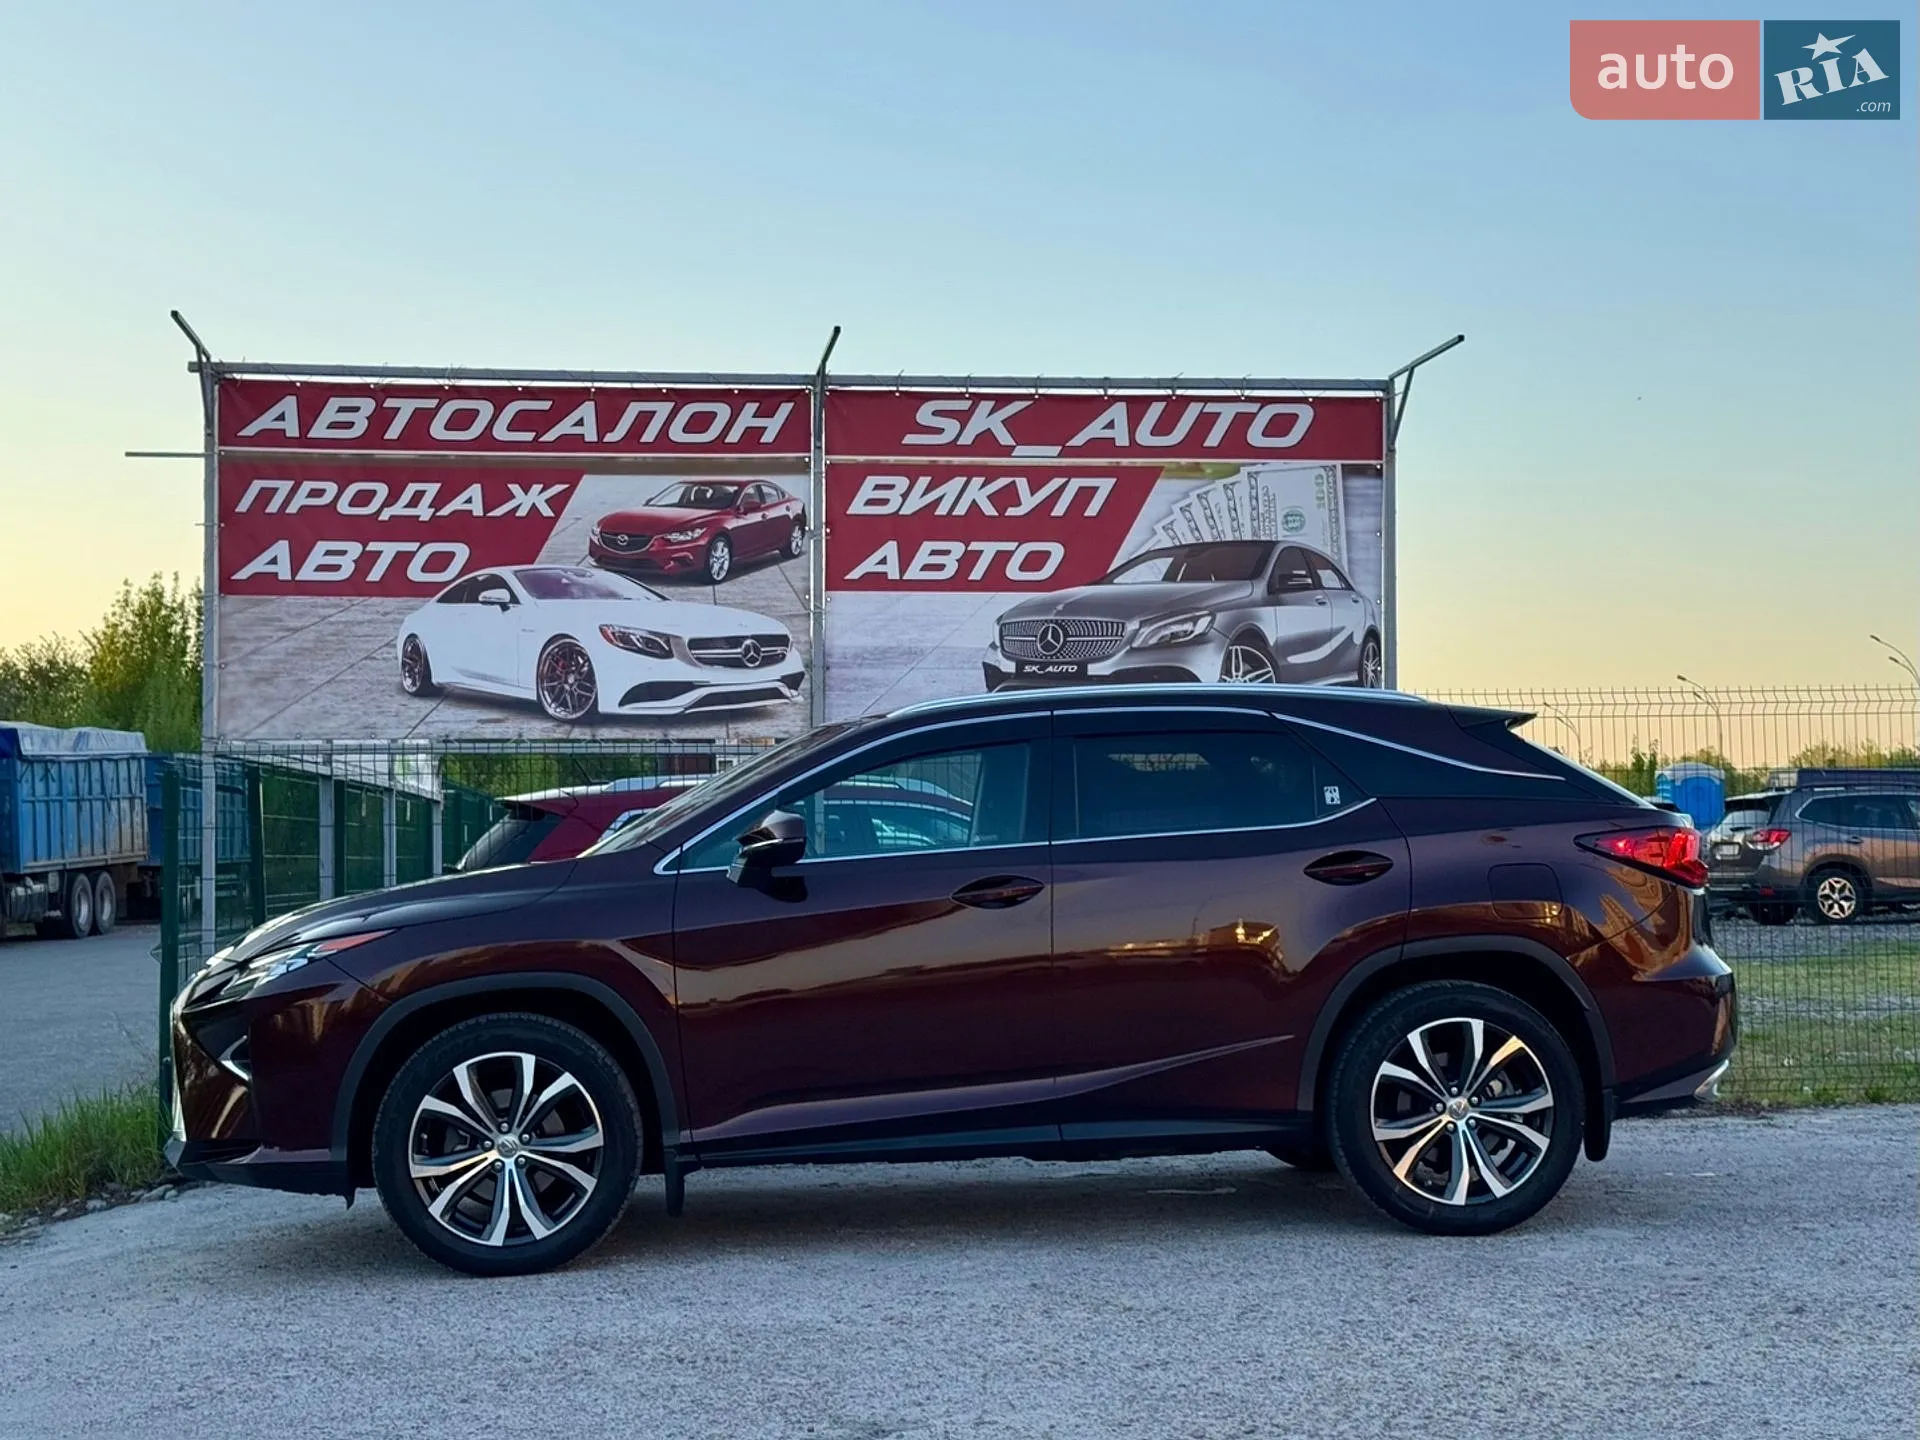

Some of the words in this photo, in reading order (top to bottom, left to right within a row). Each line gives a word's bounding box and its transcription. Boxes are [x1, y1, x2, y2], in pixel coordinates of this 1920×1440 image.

[236, 394, 796, 445] АВТОСАЛОН
[902, 400, 1316, 458] SK_AUTO
[234, 479, 570, 522] ПРОДАЖ
[845, 475, 1118, 518] ВИКУП
[230, 539, 471, 583] АВТО
[843, 540, 1066, 581] АВТО
[1023, 664, 1078, 674] SK_AUTO
